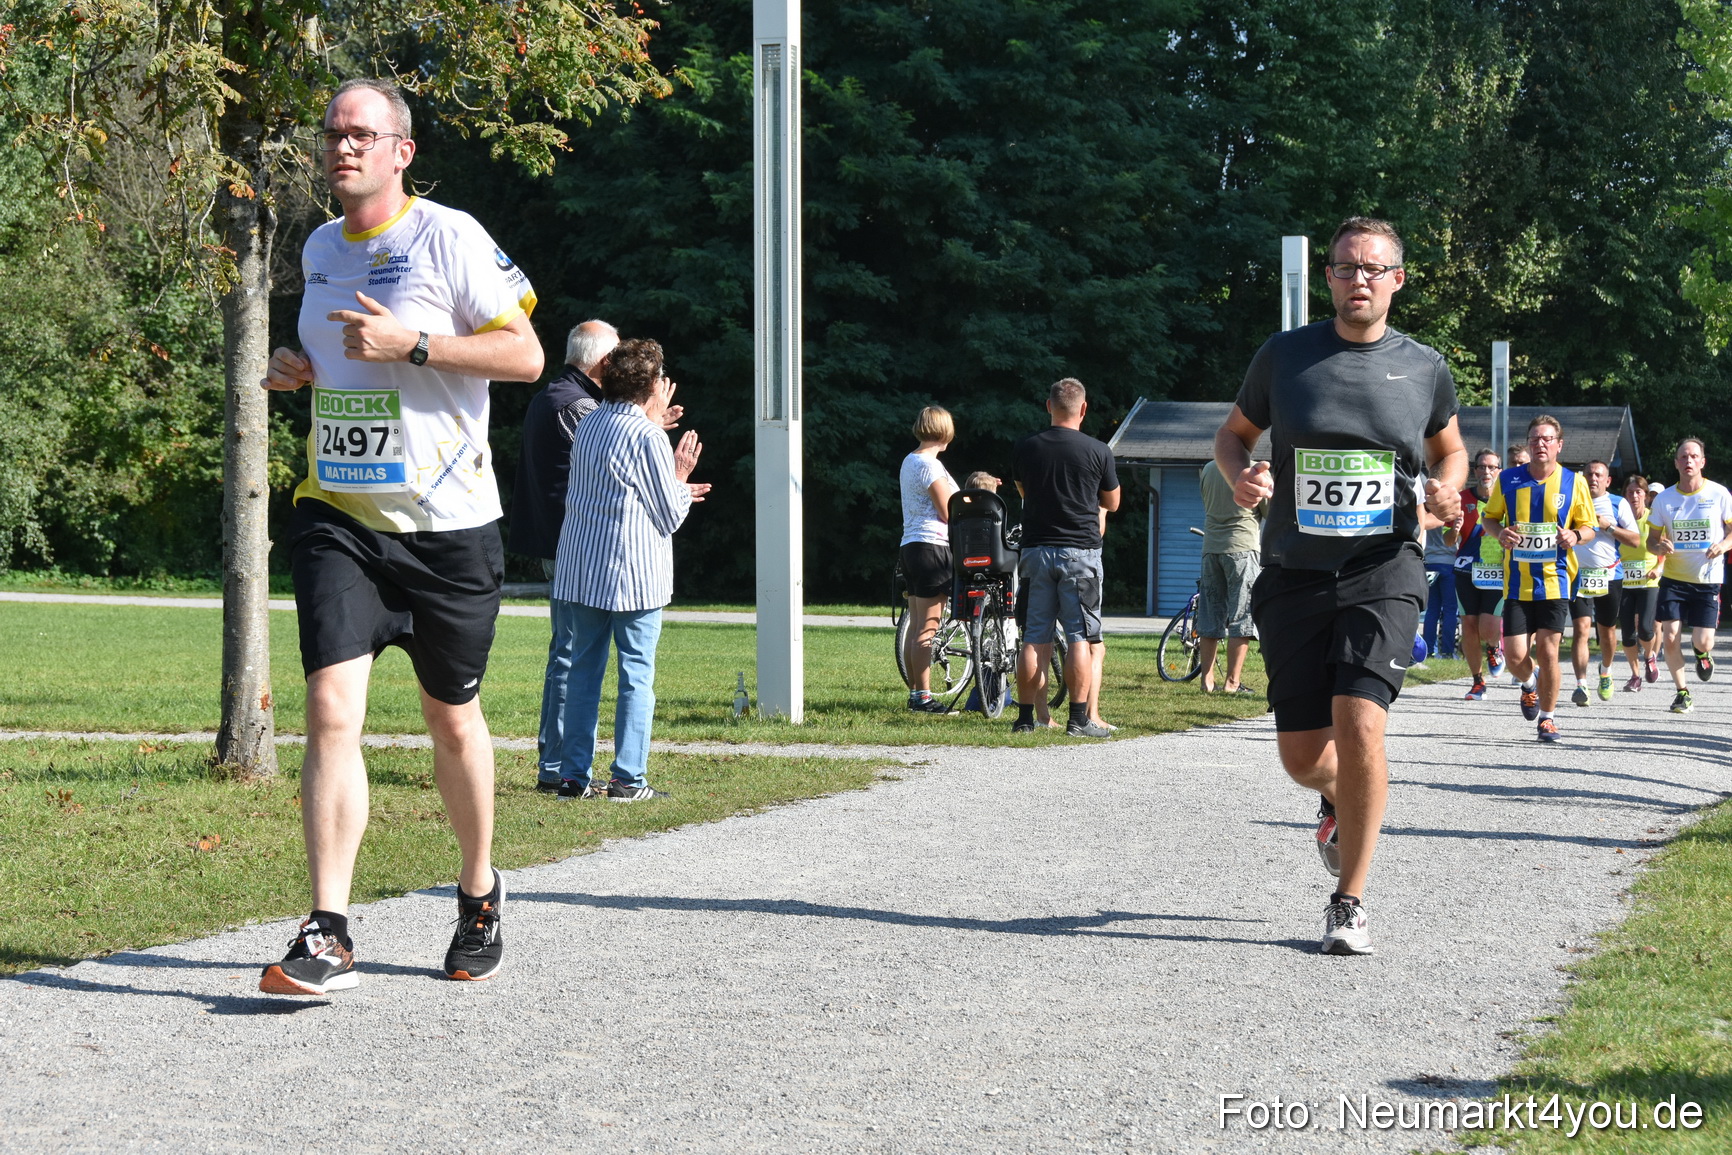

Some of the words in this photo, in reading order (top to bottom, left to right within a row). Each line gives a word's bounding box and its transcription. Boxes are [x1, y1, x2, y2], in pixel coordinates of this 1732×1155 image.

[372, 252, 389, 267] 20
[368, 275, 401, 286] Stadtlauf
[319, 393, 392, 416] BOCK
[322, 424, 390, 457] 2497
[1303, 453, 1386, 473] BOCK
[325, 465, 387, 480] MATHIAS
[1307, 480, 1381, 506] 2672
[1314, 514, 1374, 526] MARCEL
[1674, 520, 1707, 529] BOCK
[1517, 524, 1553, 534] BOCK
[1677, 530, 1706, 541] 2323
[1518, 536, 1551, 549] 2701
[1476, 570, 1504, 579] 2693
[1624, 569, 1642, 579] 143
